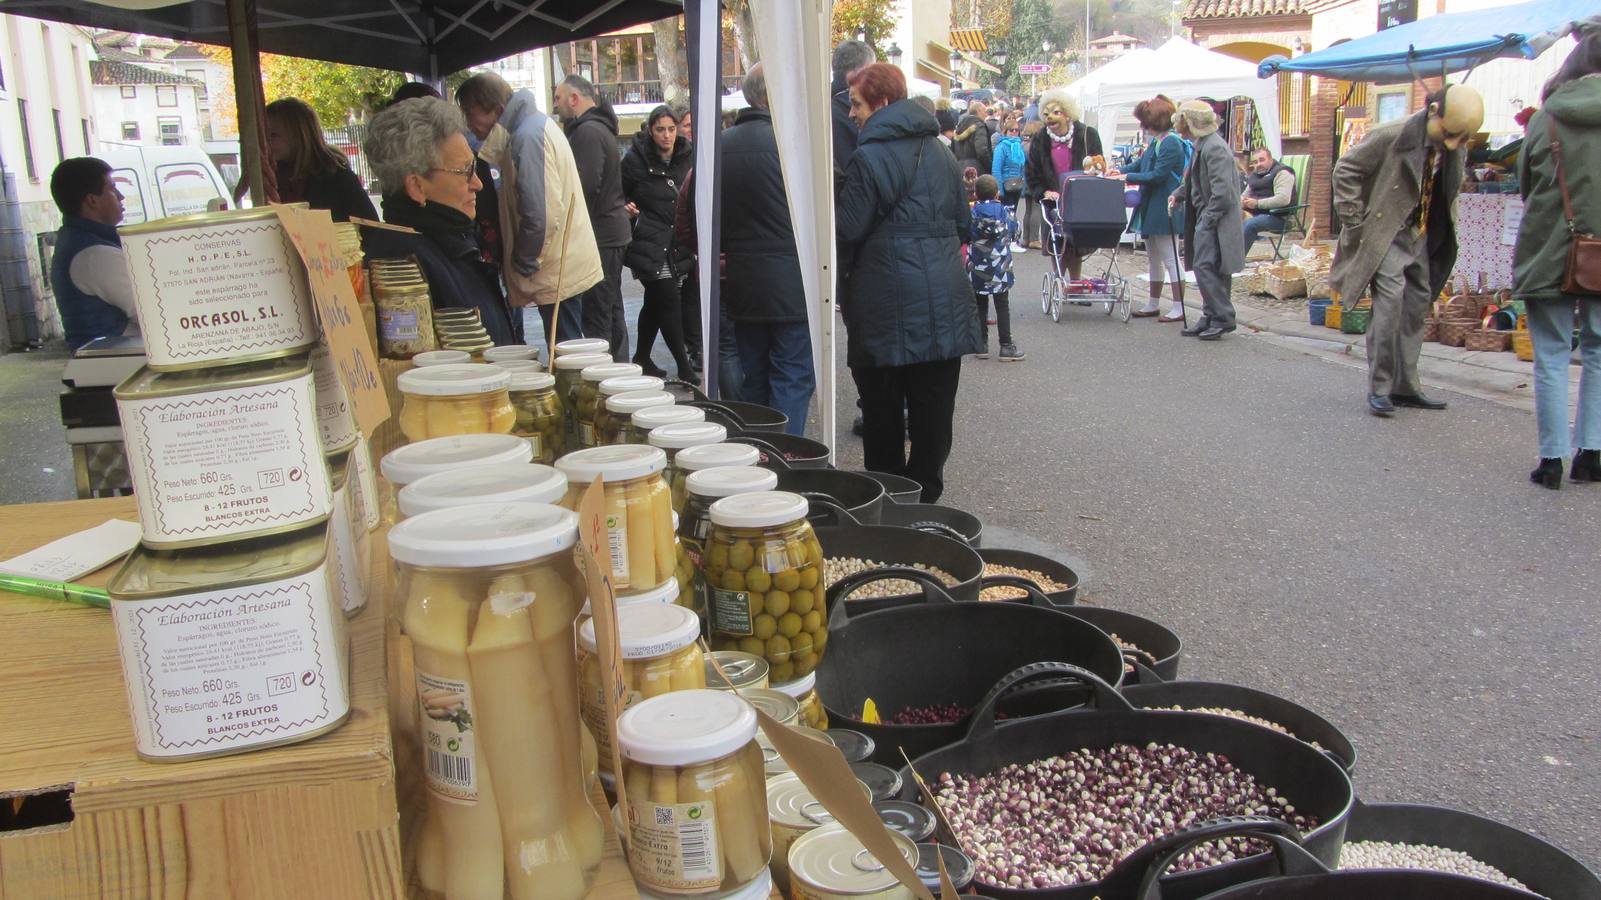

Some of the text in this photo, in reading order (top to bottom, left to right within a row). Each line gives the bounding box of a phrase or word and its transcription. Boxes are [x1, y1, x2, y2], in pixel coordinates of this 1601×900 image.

[194, 238, 240, 250] CONSERVAS
[206, 292, 250, 303] seleccionado
[258, 304, 283, 319] S.L.
[191, 329, 228, 339] ARENZANA
[158, 400, 278, 423] Elaboración Artesana
[324, 406, 336, 416] 720
[164, 478, 180, 488] Peso
[200, 471, 218, 484] 660
[264, 471, 280, 484] 720
[166, 493, 182, 502] Peso
[217, 483, 235, 496] 425
[231, 497, 268, 506] FRUTOS
[205, 512, 242, 521] BLANCOS
[157, 598, 292, 625] Elaboración Artesana
[162, 686, 181, 700] Peso
[202, 678, 223, 692] 660
[273, 676, 291, 690] 720
[164, 703, 183, 714] Peso
[221, 692, 242, 705] 425
[236, 705, 278, 716] FRUTOS
[208, 716, 279, 733] BLANCOS EXTRA
